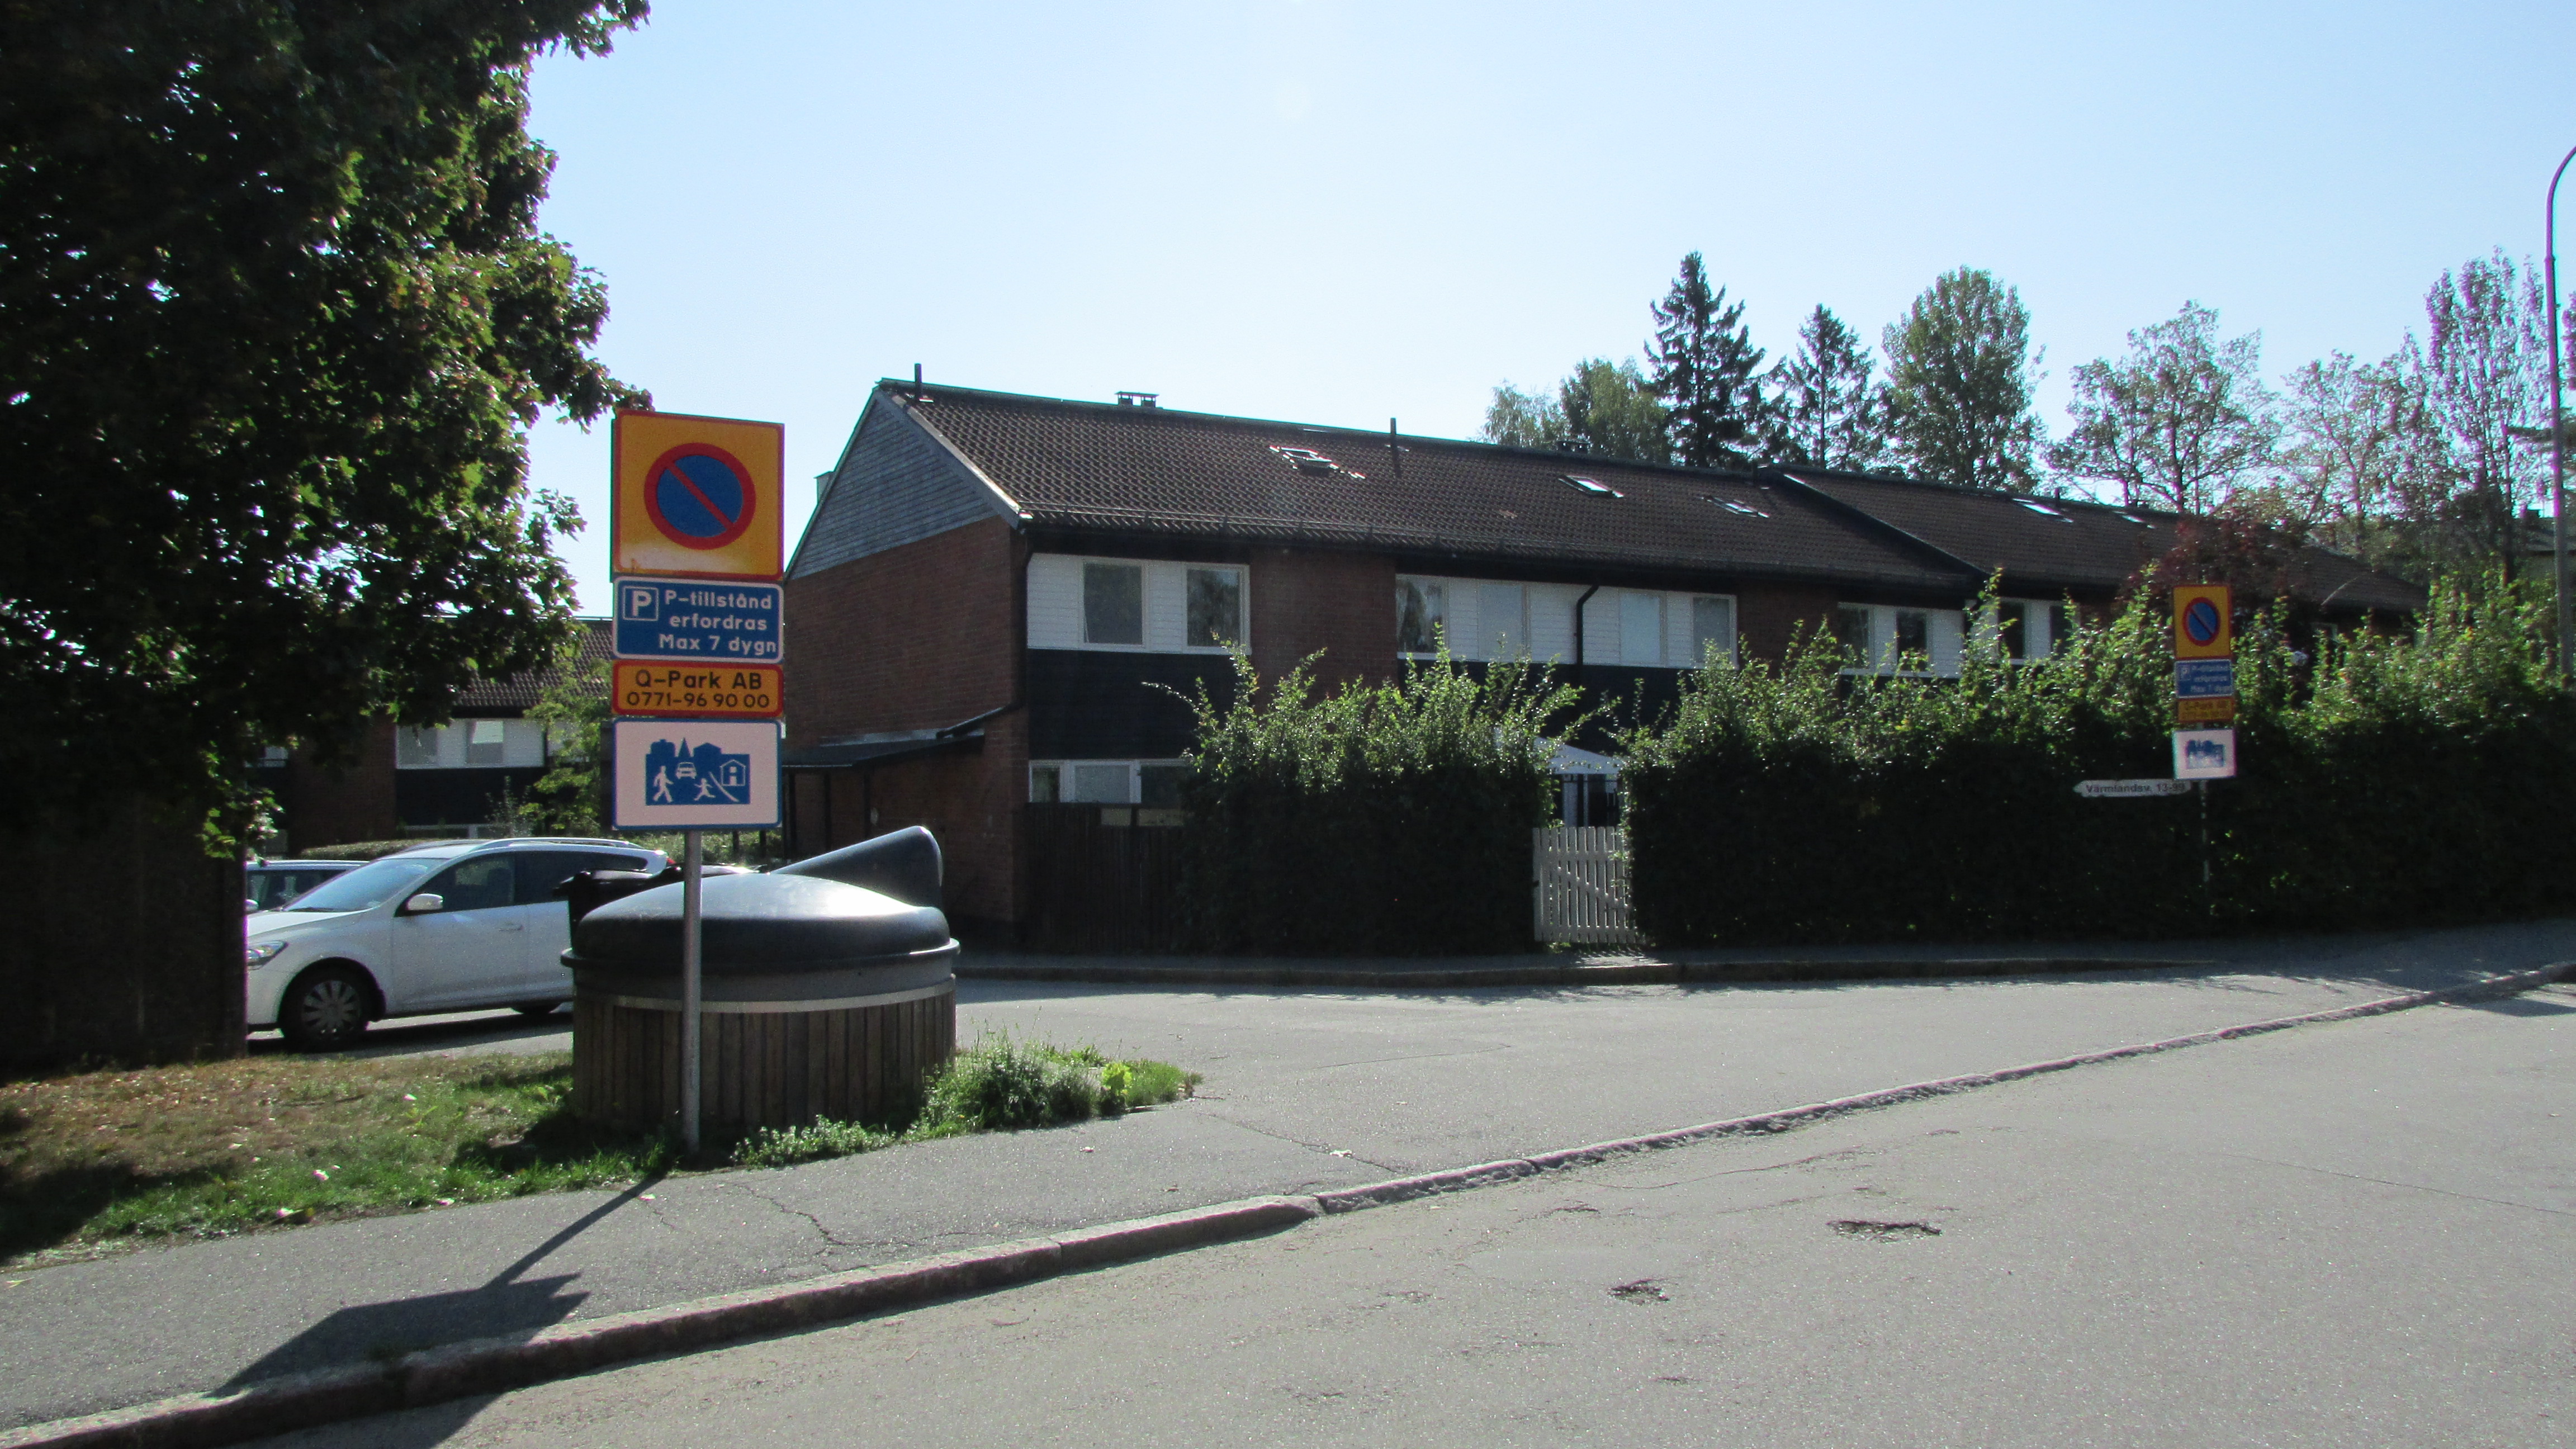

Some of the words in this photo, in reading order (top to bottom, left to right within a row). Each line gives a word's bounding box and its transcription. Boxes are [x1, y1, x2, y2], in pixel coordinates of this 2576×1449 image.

[632, 590, 652, 616] P
[665, 590, 771, 609] P-tillstånd
[670, 614, 767, 631] erfordras
[659, 633, 700, 650] Max
[708, 636, 720, 650] 7
[728, 637, 776, 655] dygn
[635, 670, 721, 689] Q-Park
[732, 673, 761, 690] AB
[627, 692, 707, 707] 0771-96
[713, 693, 738, 707] 90
[744, 694, 769, 708] 00
